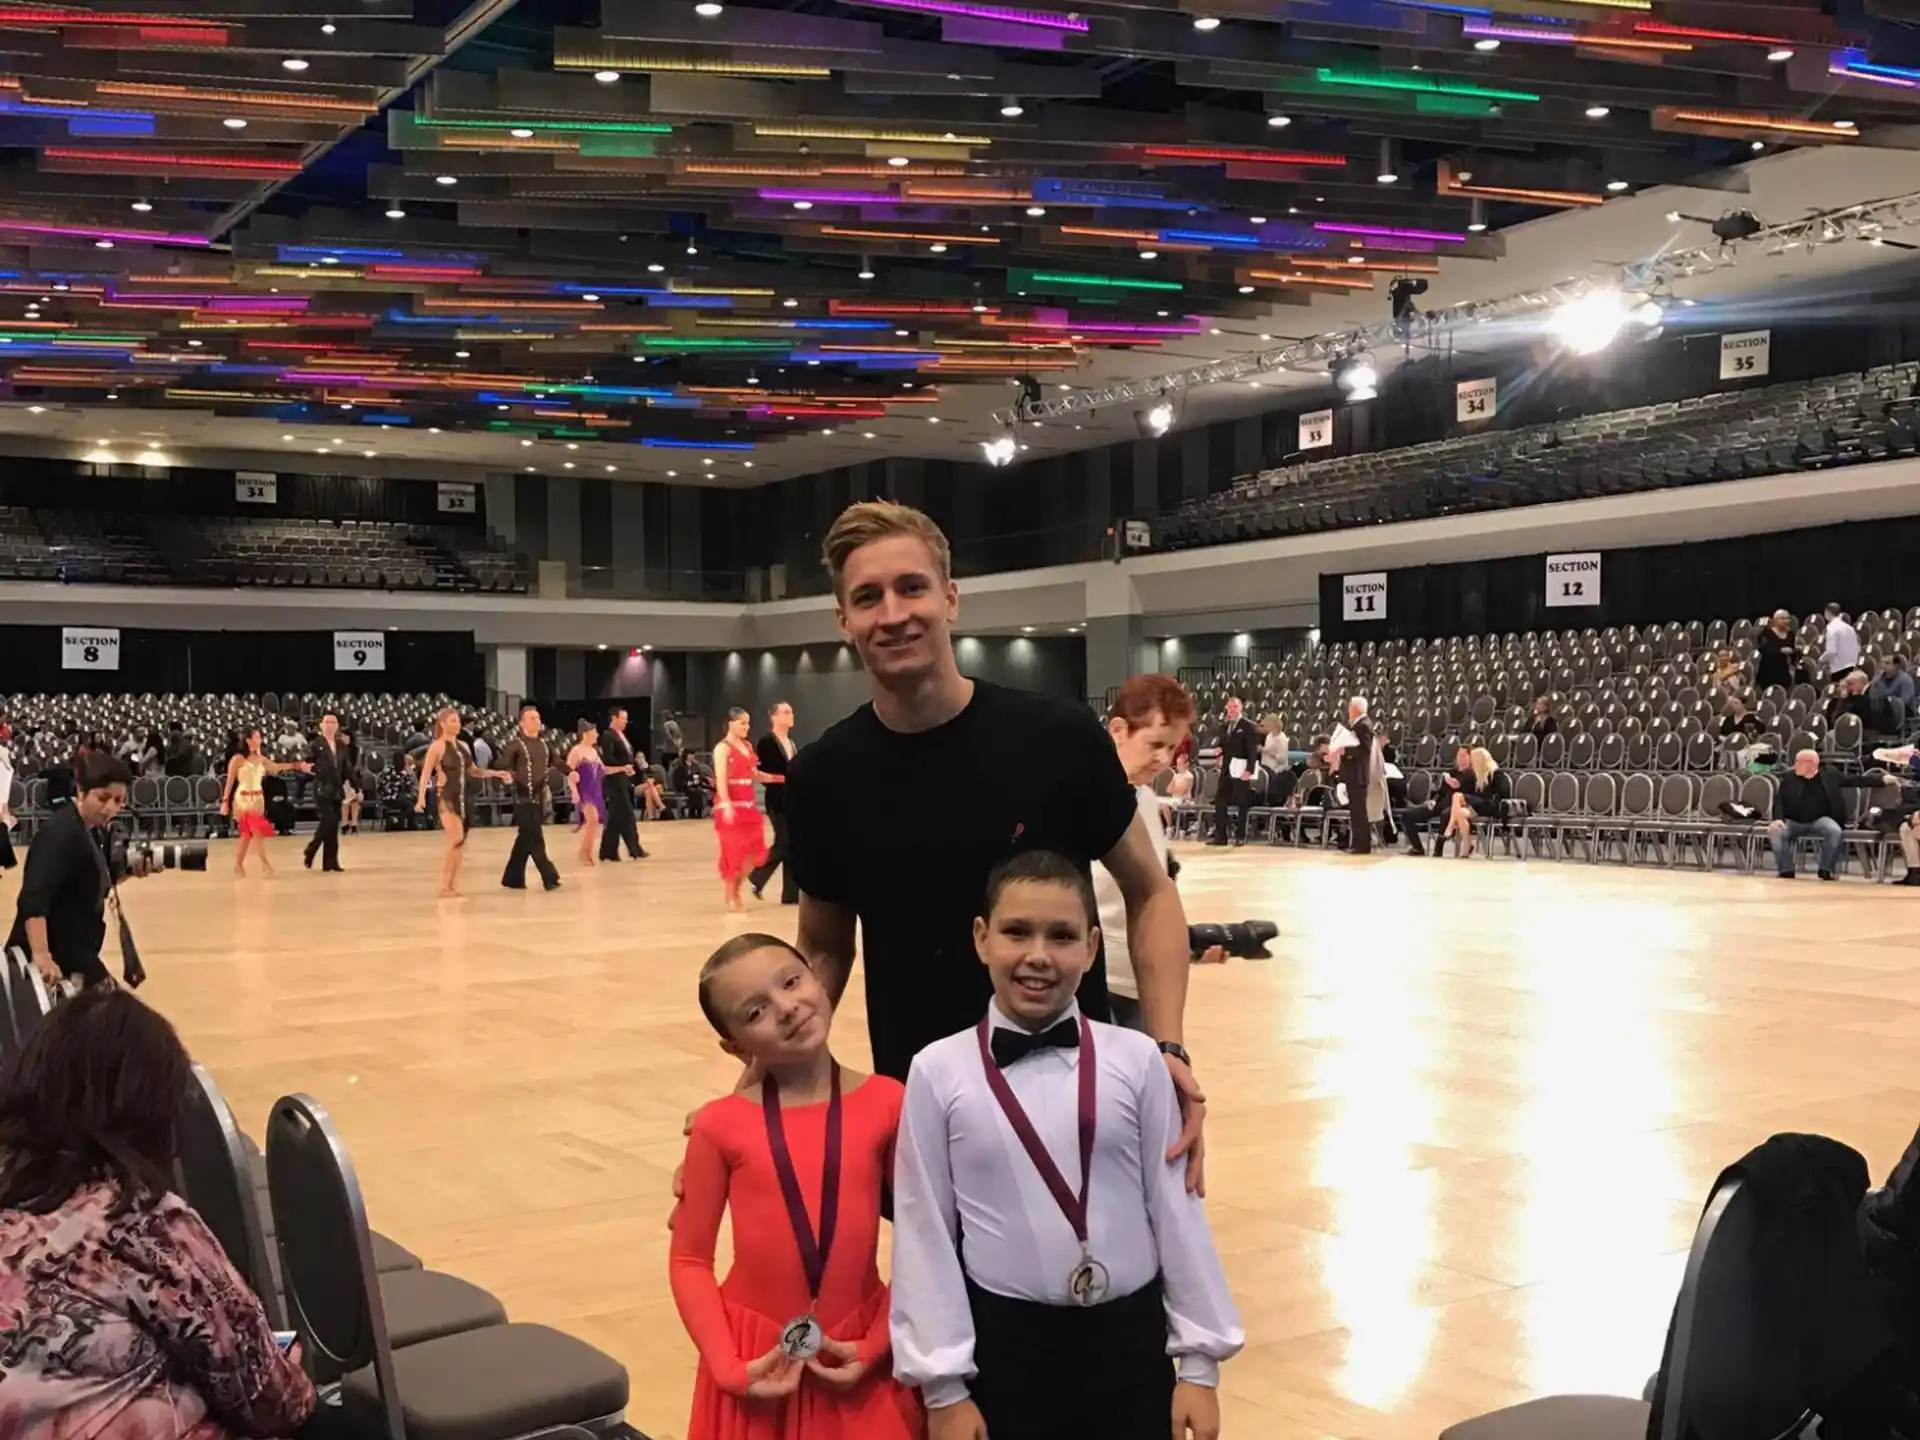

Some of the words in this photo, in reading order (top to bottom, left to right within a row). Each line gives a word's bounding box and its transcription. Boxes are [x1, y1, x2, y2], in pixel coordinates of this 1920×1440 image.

[1723, 336, 1768, 350] SECTION
[1733, 356, 1755, 371] 35
[1458, 387, 1496, 401] SECTION
[1467, 399, 1486, 414] 34
[1308, 430, 1323, 442] 33
[247, 487, 264, 498] 31
[1548, 560, 1599, 573] SECTION
[1345, 582, 1385, 594] SECTION
[1562, 582, 1583, 597] 12
[1354, 595, 1377, 612] 11
[64, 636, 118, 646] SECTION
[336, 640, 383, 649] SECTION
[83, 646, 100, 663] 8
[353, 650, 366, 667] 9
